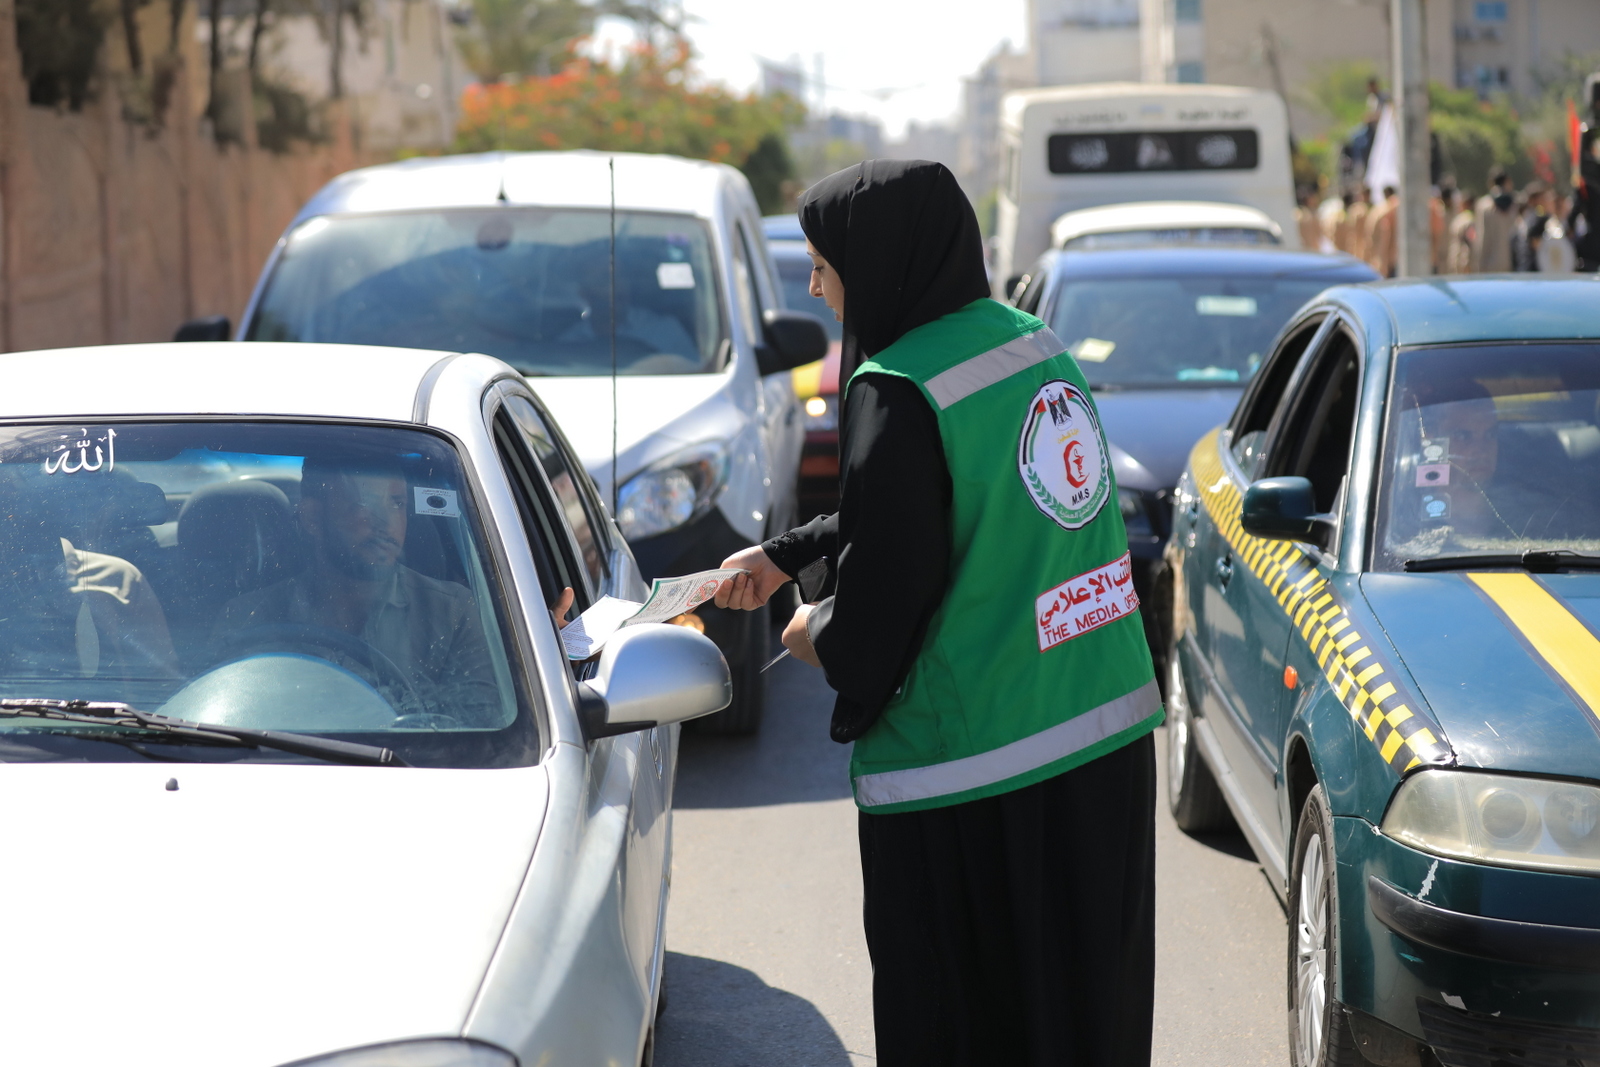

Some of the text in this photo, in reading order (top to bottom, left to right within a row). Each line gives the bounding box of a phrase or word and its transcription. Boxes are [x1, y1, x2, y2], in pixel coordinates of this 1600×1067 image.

[1040, 572, 1113, 629] الإعلامي
[1045, 622, 1070, 645] THE
[1075, 602, 1121, 631] MEDIA
